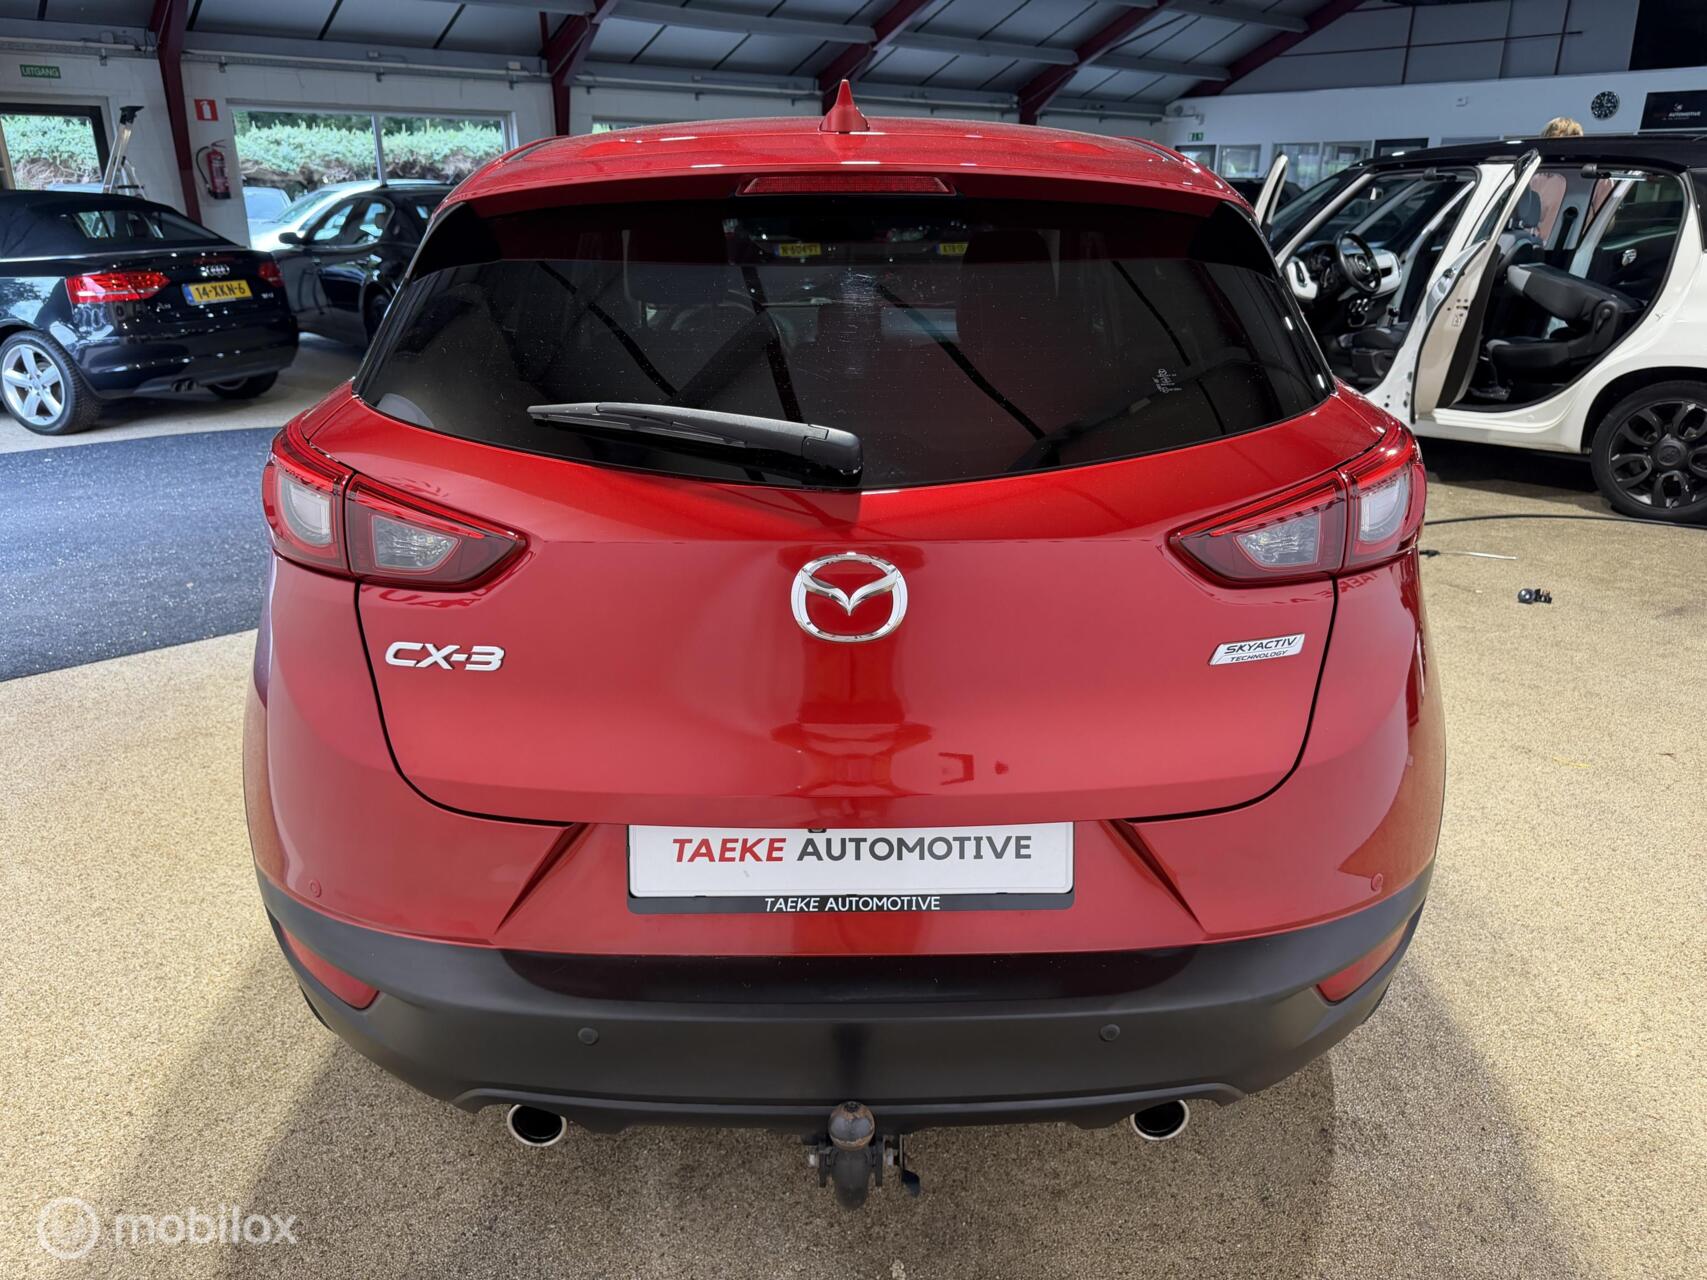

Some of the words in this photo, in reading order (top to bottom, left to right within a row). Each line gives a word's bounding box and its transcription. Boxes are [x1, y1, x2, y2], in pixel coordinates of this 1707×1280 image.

[21, 66, 59, 77] UITGANG
[195, 283, 246, 300] 14-XKN-6
[1224, 636, 1297, 654] SKYACTIV
[385, 641, 505, 672] CX-3
[1229, 649, 1288, 662] TECHNOLOGY
[672, 837, 786, 863] TAEKE
[797, 835, 1032, 862] AUTOMOTIVE
[764, 897, 819, 912] TAEKE
[825, 896, 940, 912] AUTOMOTIVE
